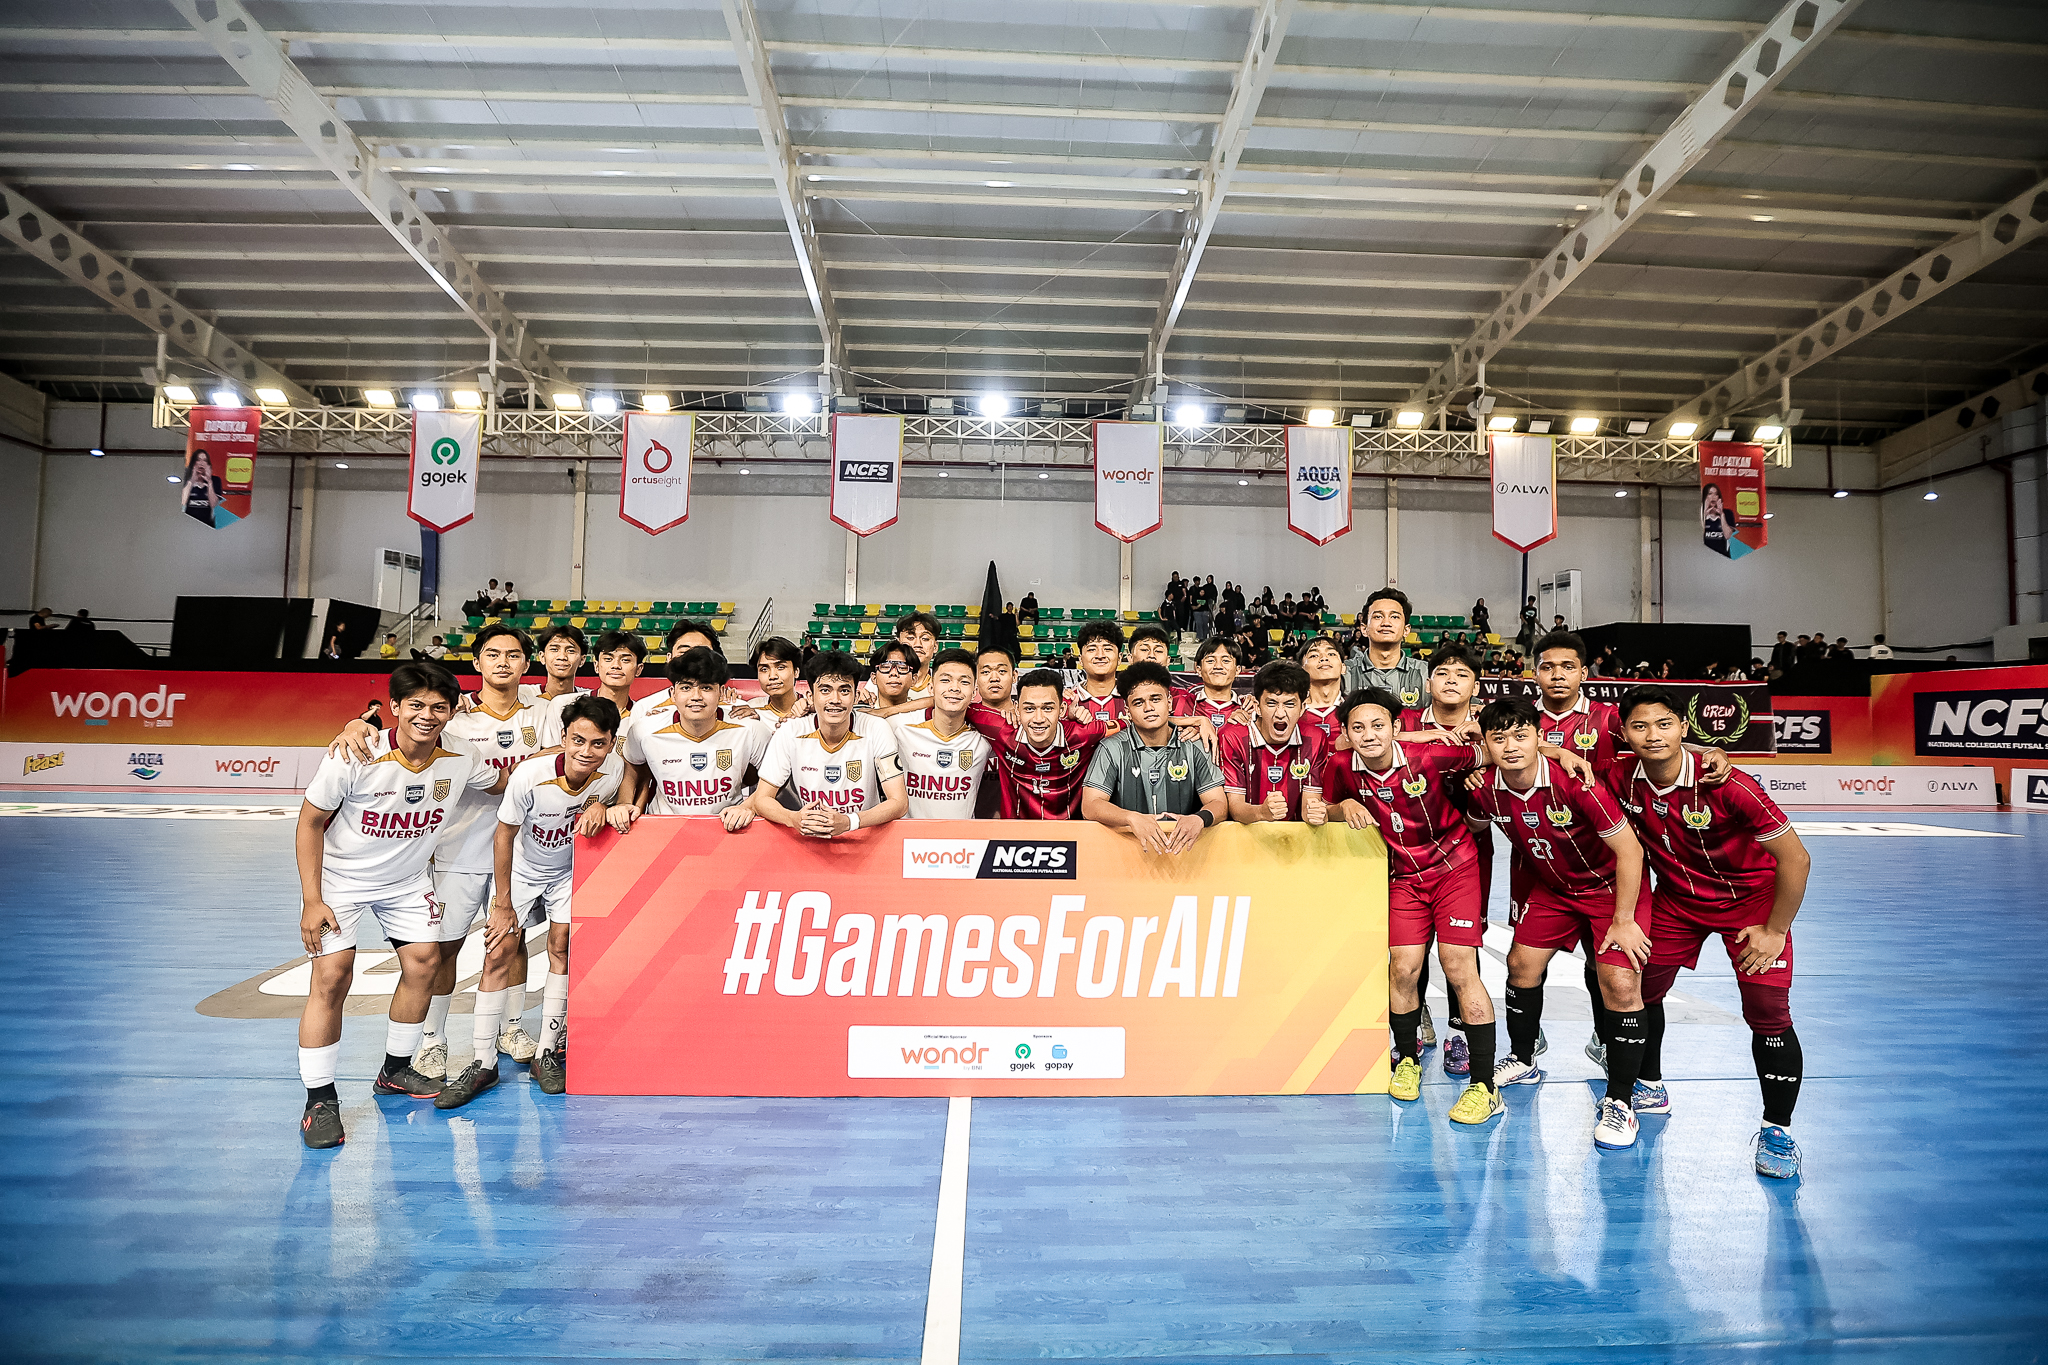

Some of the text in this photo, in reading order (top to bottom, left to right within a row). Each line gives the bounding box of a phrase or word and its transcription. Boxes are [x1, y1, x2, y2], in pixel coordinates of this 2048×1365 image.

[844, 463, 889, 476] NCFS
[1102, 468, 1154, 481] wondr
[1296, 466, 1341, 484] AQUA
[421, 470, 468, 487] gojek
[631, 475, 682, 486] ortuseight
[1511, 484, 1549, 494] ALVA
[1484, 683, 1511, 695] WE
[51, 684, 186, 718] wondr
[1702, 704, 1736, 718] CREW
[1712, 719, 1726, 731] 15
[23, 750, 64, 776] Feast
[127, 752, 164, 768] AQUA
[215, 757, 280, 773] wondr
[662, 777, 732, 797] BINUS
[907, 772, 972, 792] BINUS
[1770, 780, 1807, 791] Biznet
[1838, 776, 1896, 791] wondr
[1941, 782, 1978, 791] ALVA
[666, 792, 731, 806] UNIVERSITY
[799, 785, 865, 807] BINUS
[907, 788, 969, 801] UNIVERSITY
[361, 808, 445, 829] BINUS
[532, 820, 575, 841] BIN
[533, 834, 573, 848] UNIVER
[911, 848, 975, 864] wondr
[992, 846, 1068, 868] NCFS
[722, 889, 1251, 998] #GamesForAll
[900, 1042, 989, 1064] wondr
[1010, 1061, 1036, 1072] gojek
[1044, 1061, 1074, 1072] gopay
